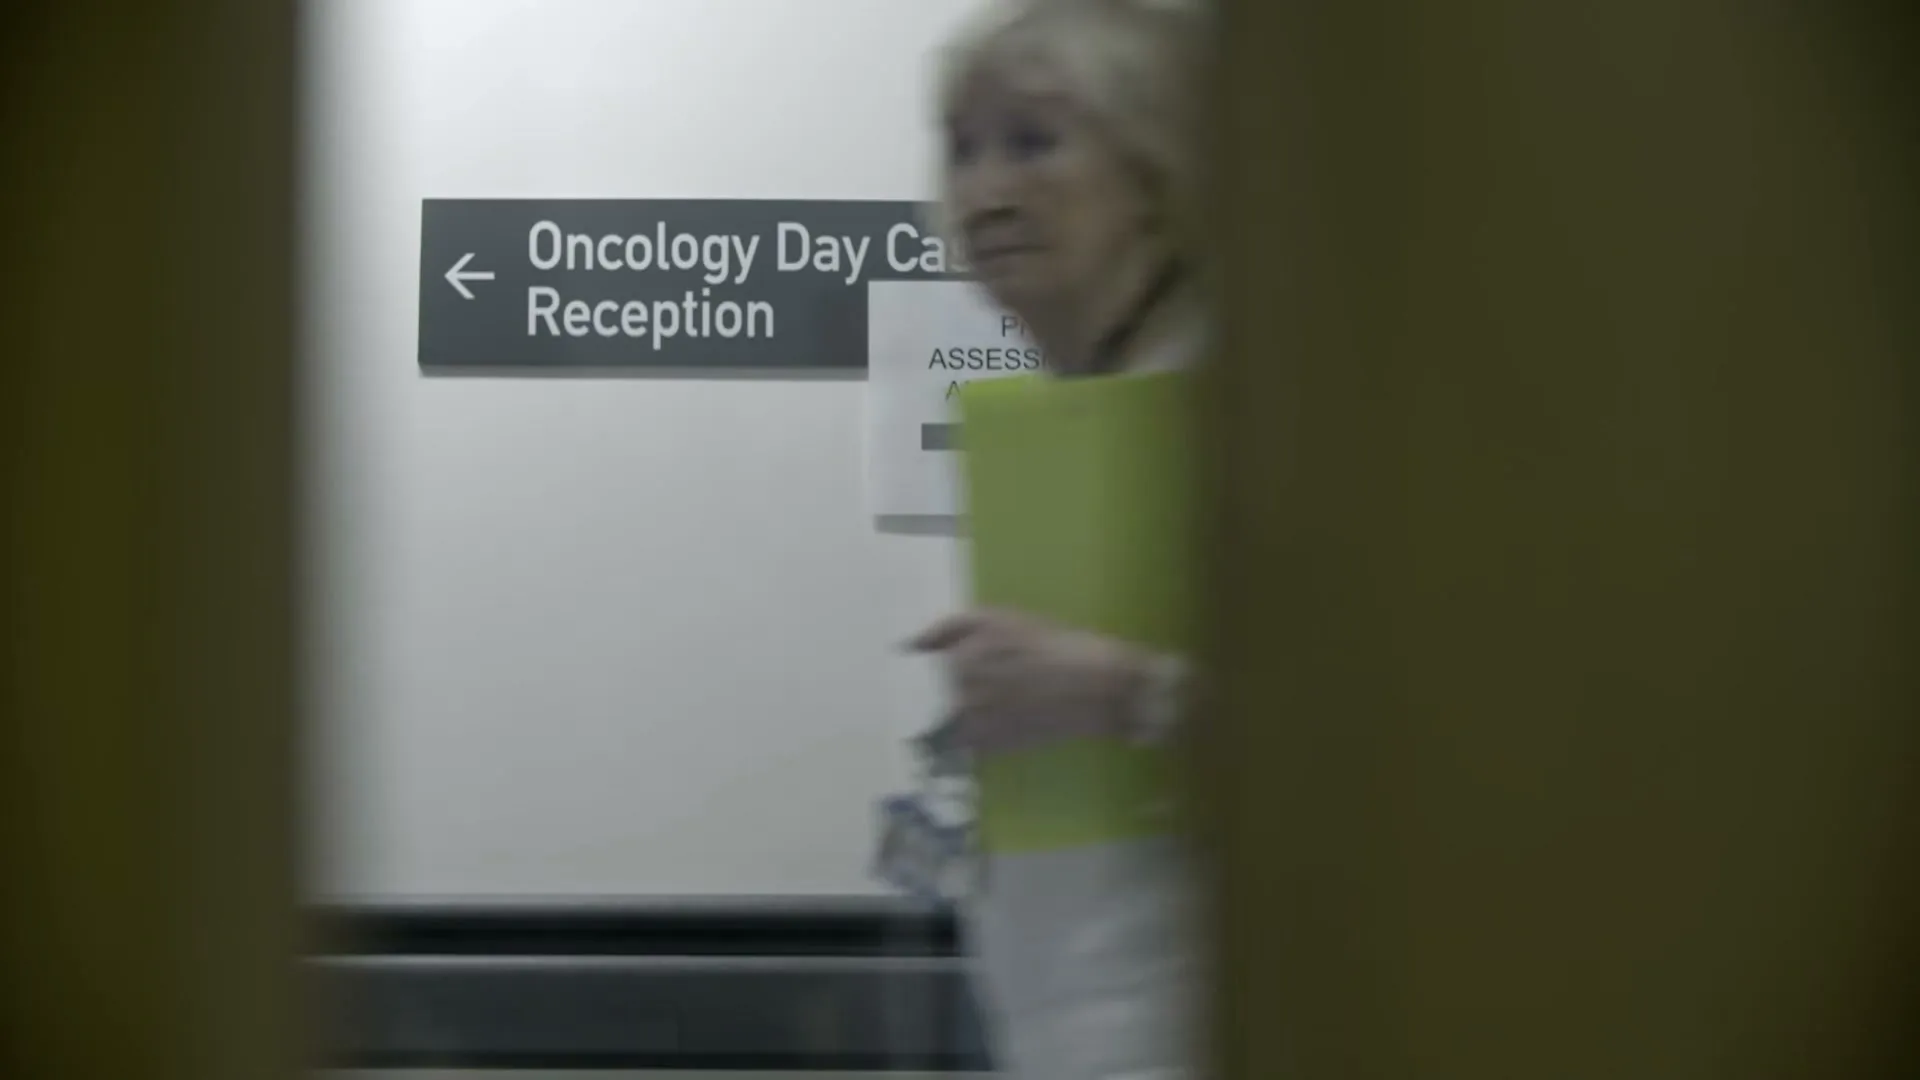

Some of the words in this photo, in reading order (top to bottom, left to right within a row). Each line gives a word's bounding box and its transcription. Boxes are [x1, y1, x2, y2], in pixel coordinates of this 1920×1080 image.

[527, 220, 760, 284] Oncology
[777, 222, 871, 284] Day
[527, 287, 775, 350] Reception
[1001, 315, 1025, 337] P
[928, 347, 1046, 370] ASSESS
